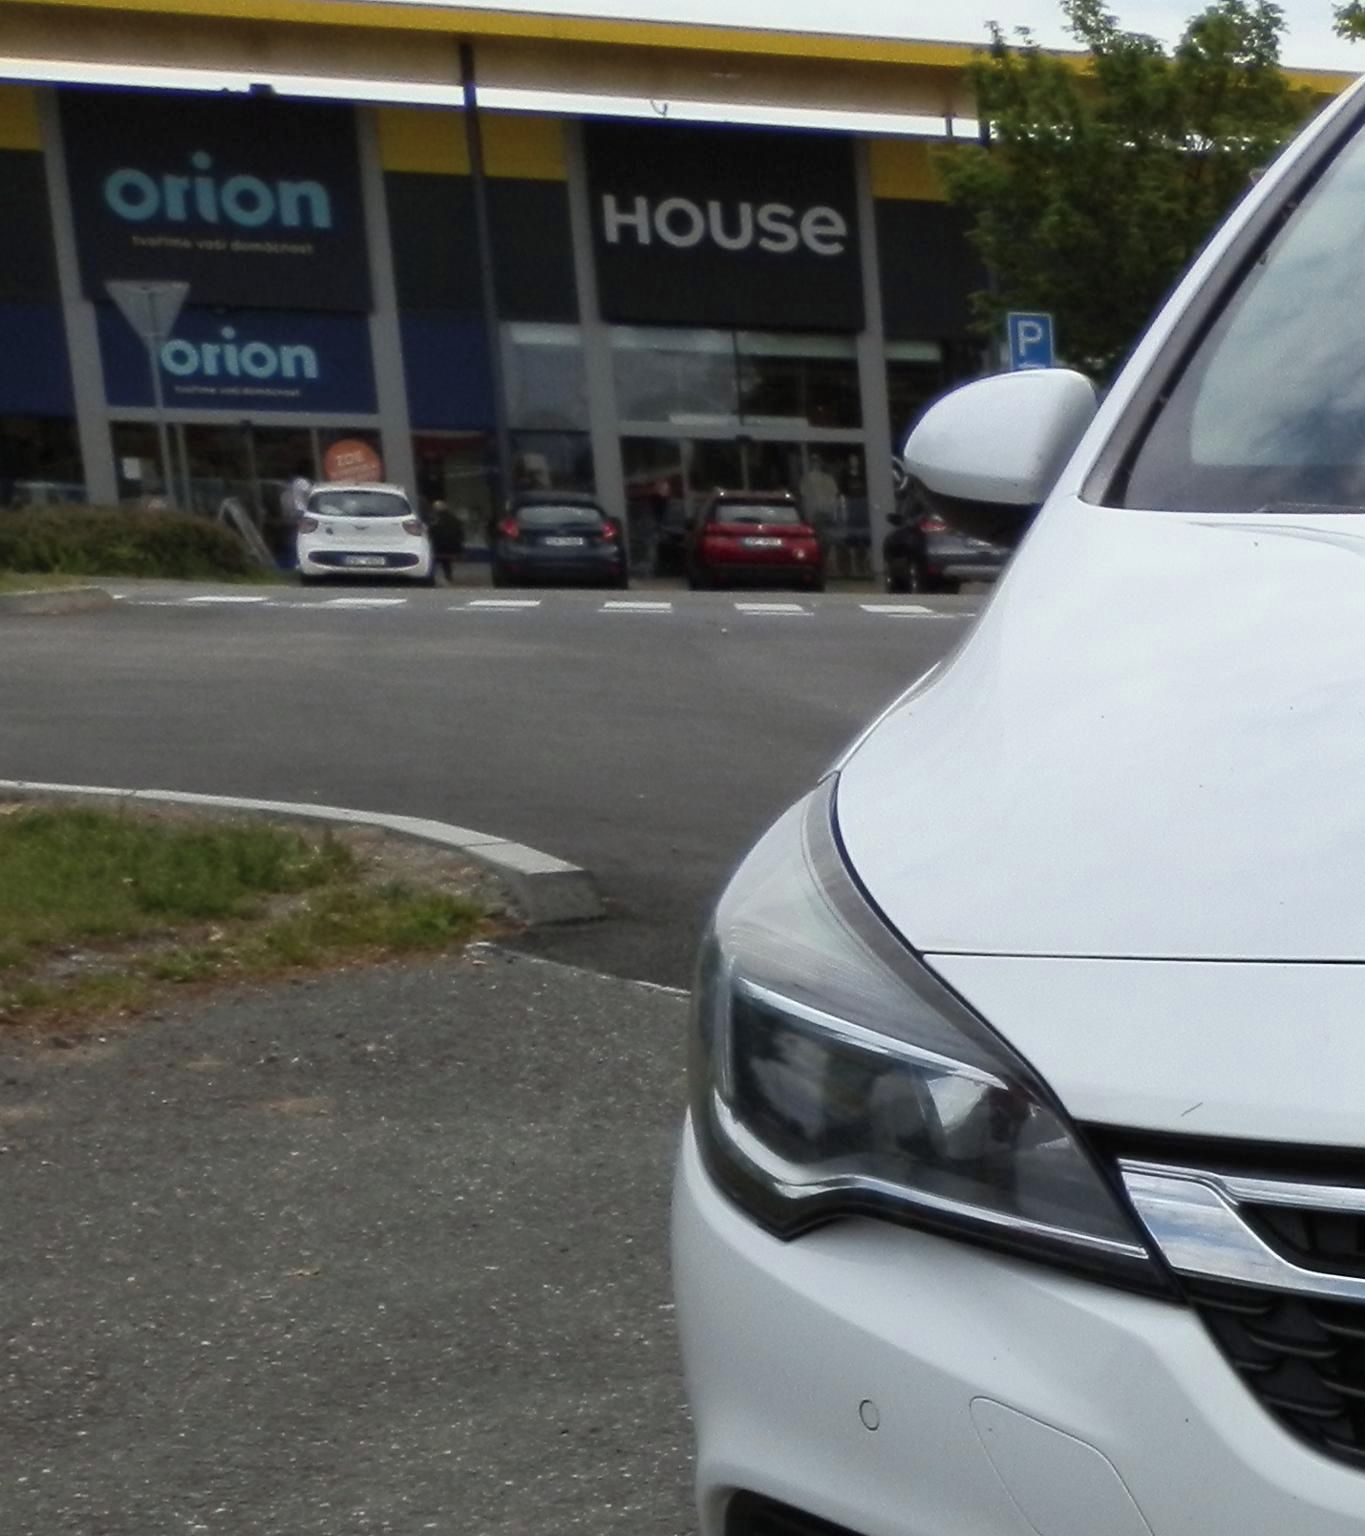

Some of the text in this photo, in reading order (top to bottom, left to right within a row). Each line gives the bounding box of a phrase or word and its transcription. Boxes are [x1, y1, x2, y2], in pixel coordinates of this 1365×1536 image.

[104, 150, 333, 229] orion
[160, 325, 319, 379] orion
[1018, 320, 1042, 356] P
